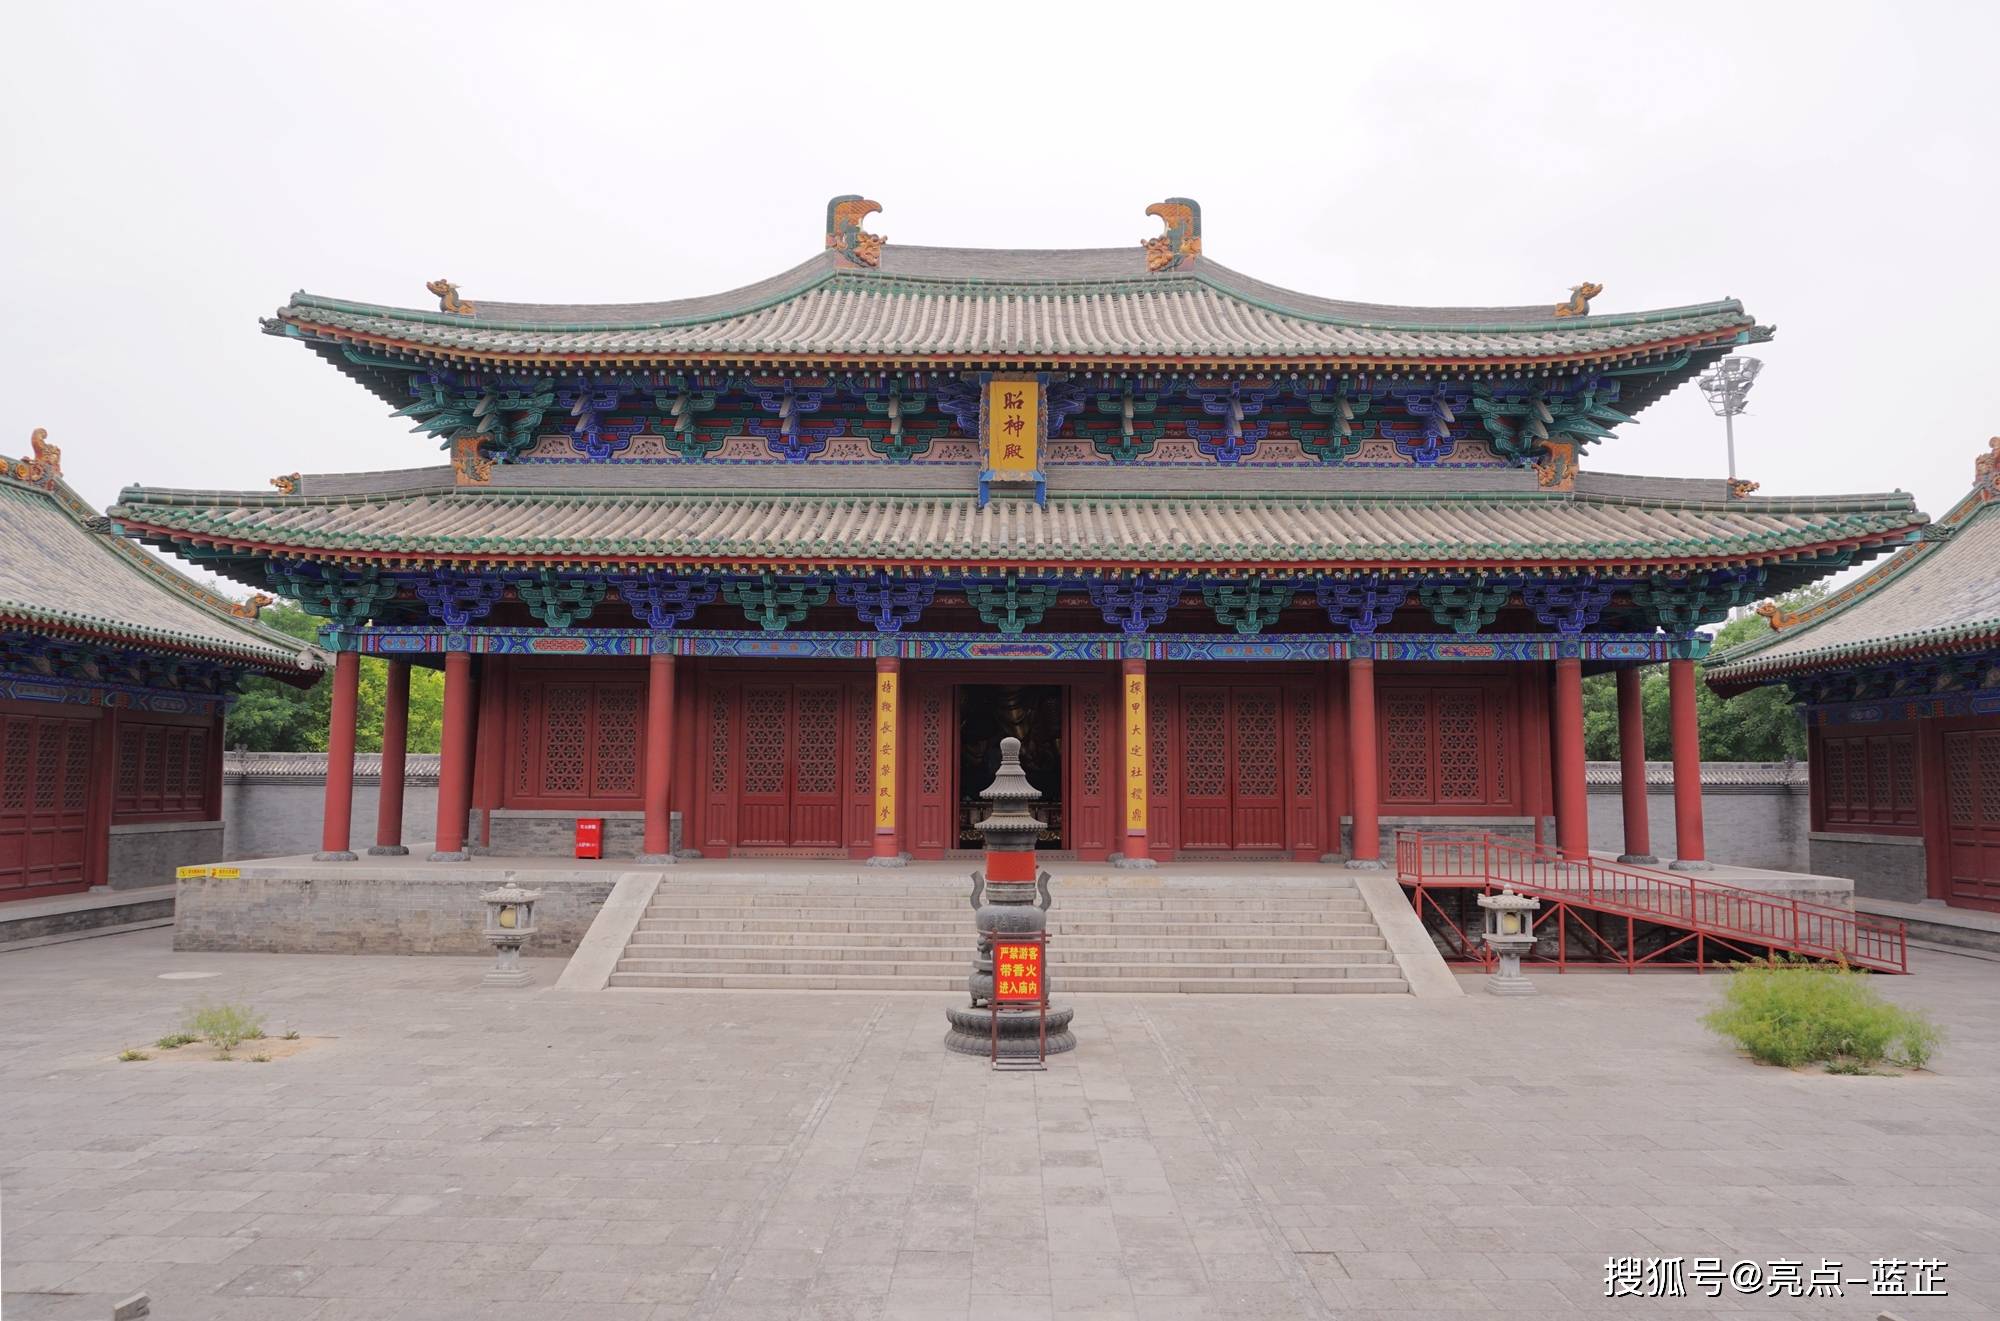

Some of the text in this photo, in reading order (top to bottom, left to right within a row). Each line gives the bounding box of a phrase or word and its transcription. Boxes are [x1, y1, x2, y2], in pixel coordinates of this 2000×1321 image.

[999, 947, 1038, 960] 严禁游客
[1000, 964, 1037, 977] 带香火
[999, 981, 1037, 994] 进入庙内
